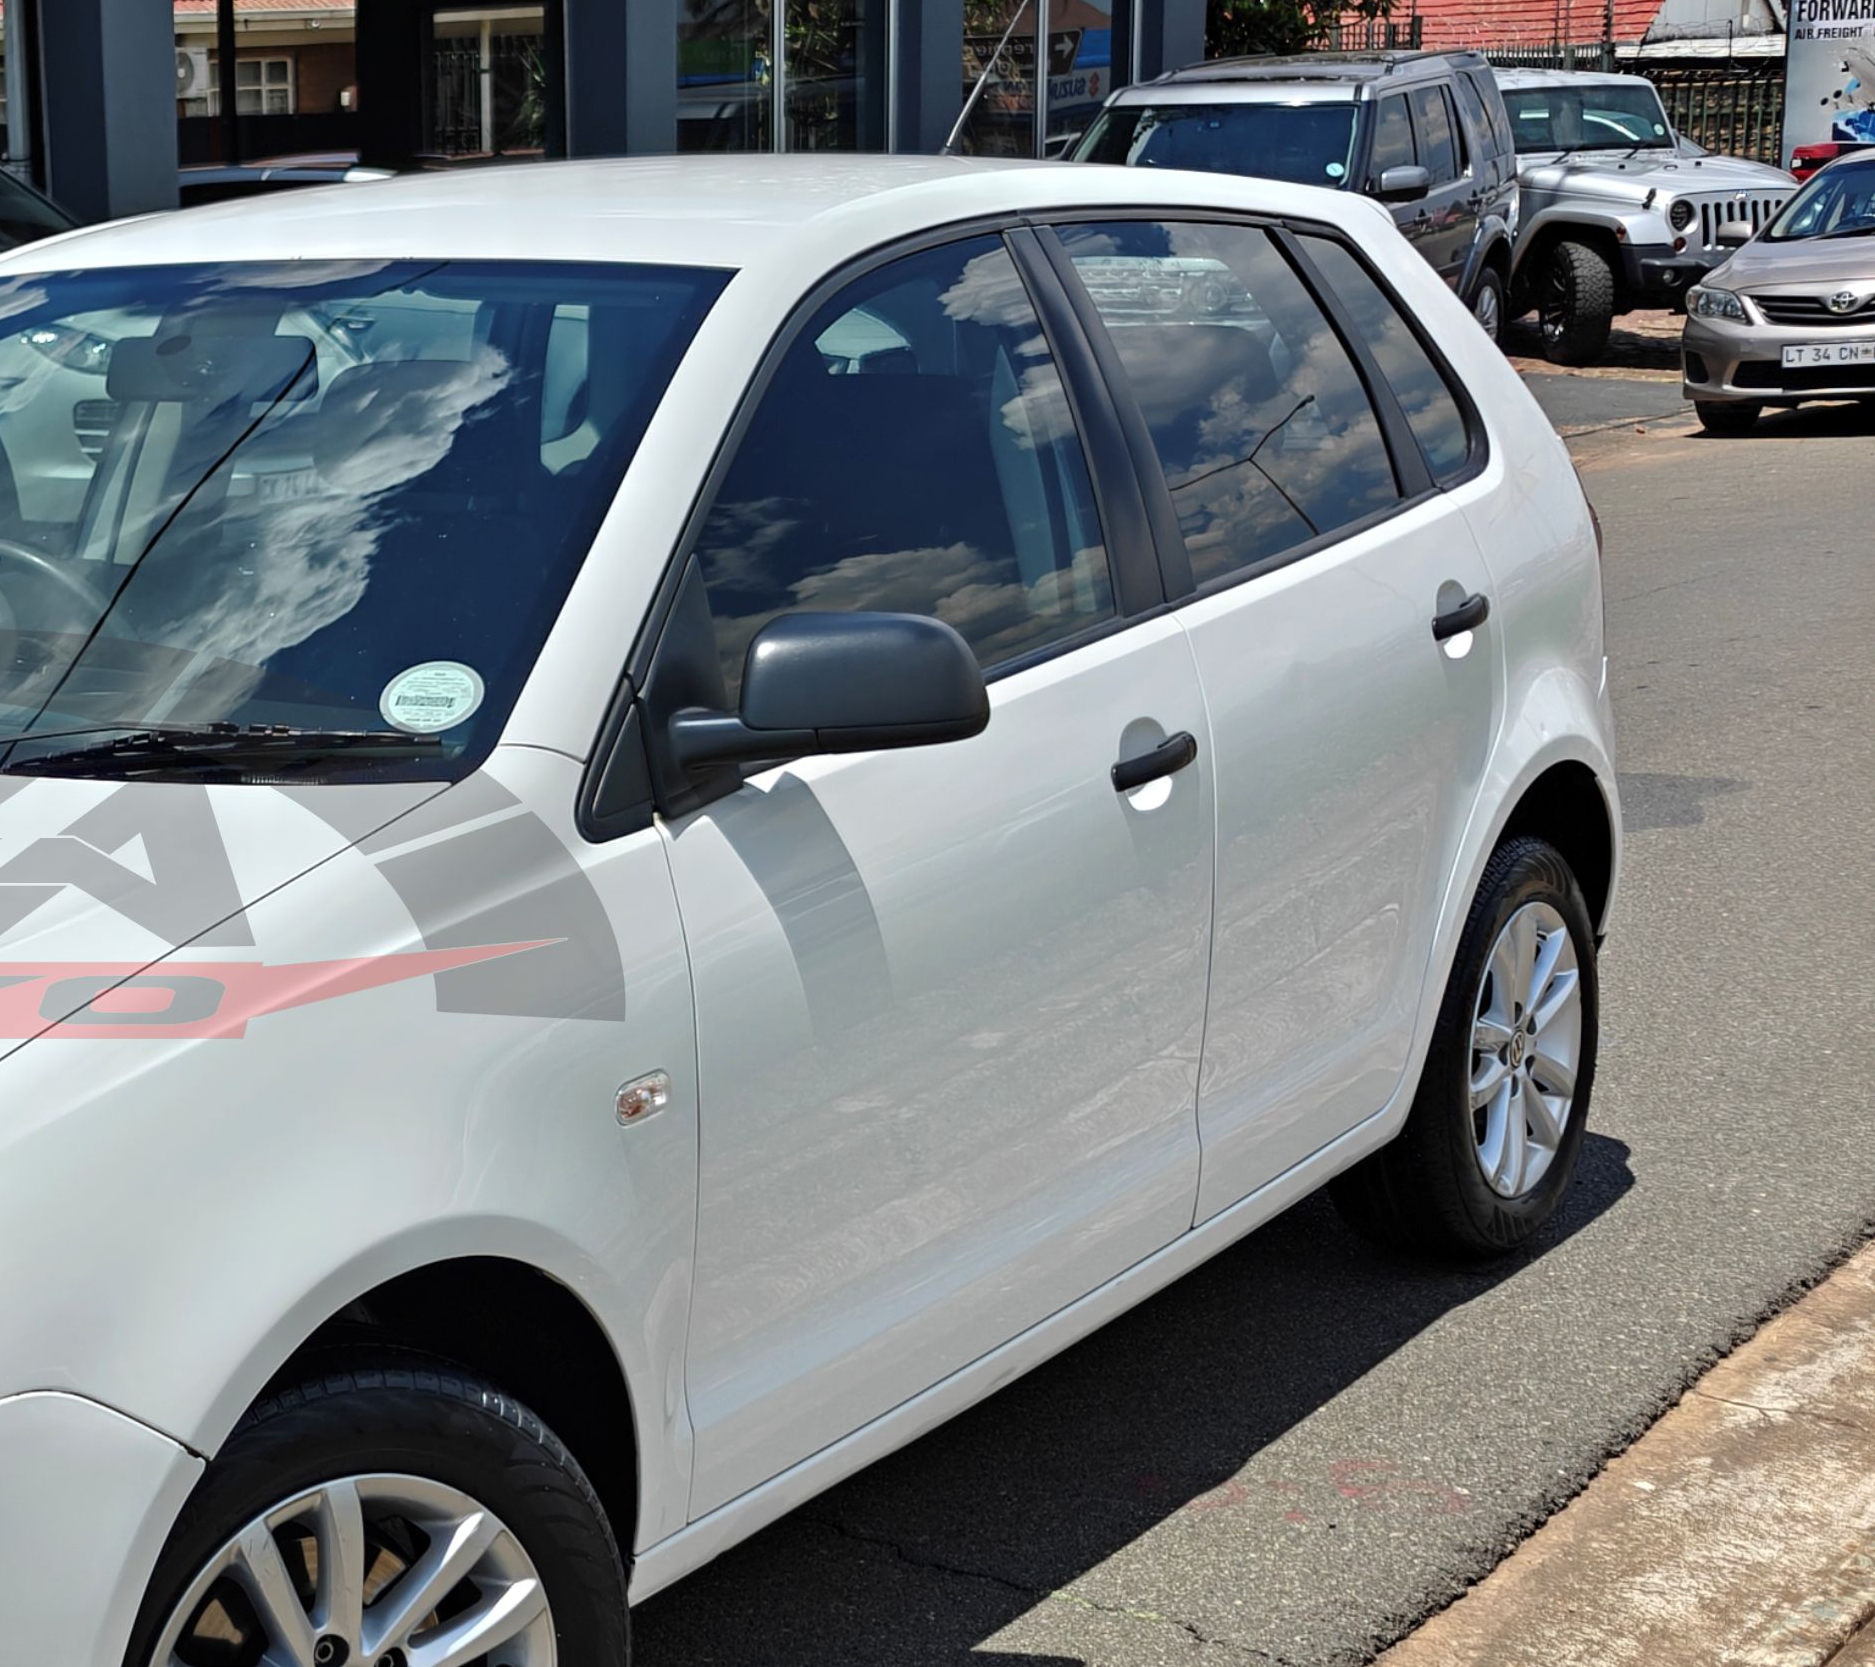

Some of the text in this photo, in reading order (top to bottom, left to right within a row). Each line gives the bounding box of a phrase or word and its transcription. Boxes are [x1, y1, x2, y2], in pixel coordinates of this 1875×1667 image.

[1816, 27, 1864, 39] FREIGHT
[1786, 346, 1859, 363] LT 34 CN
